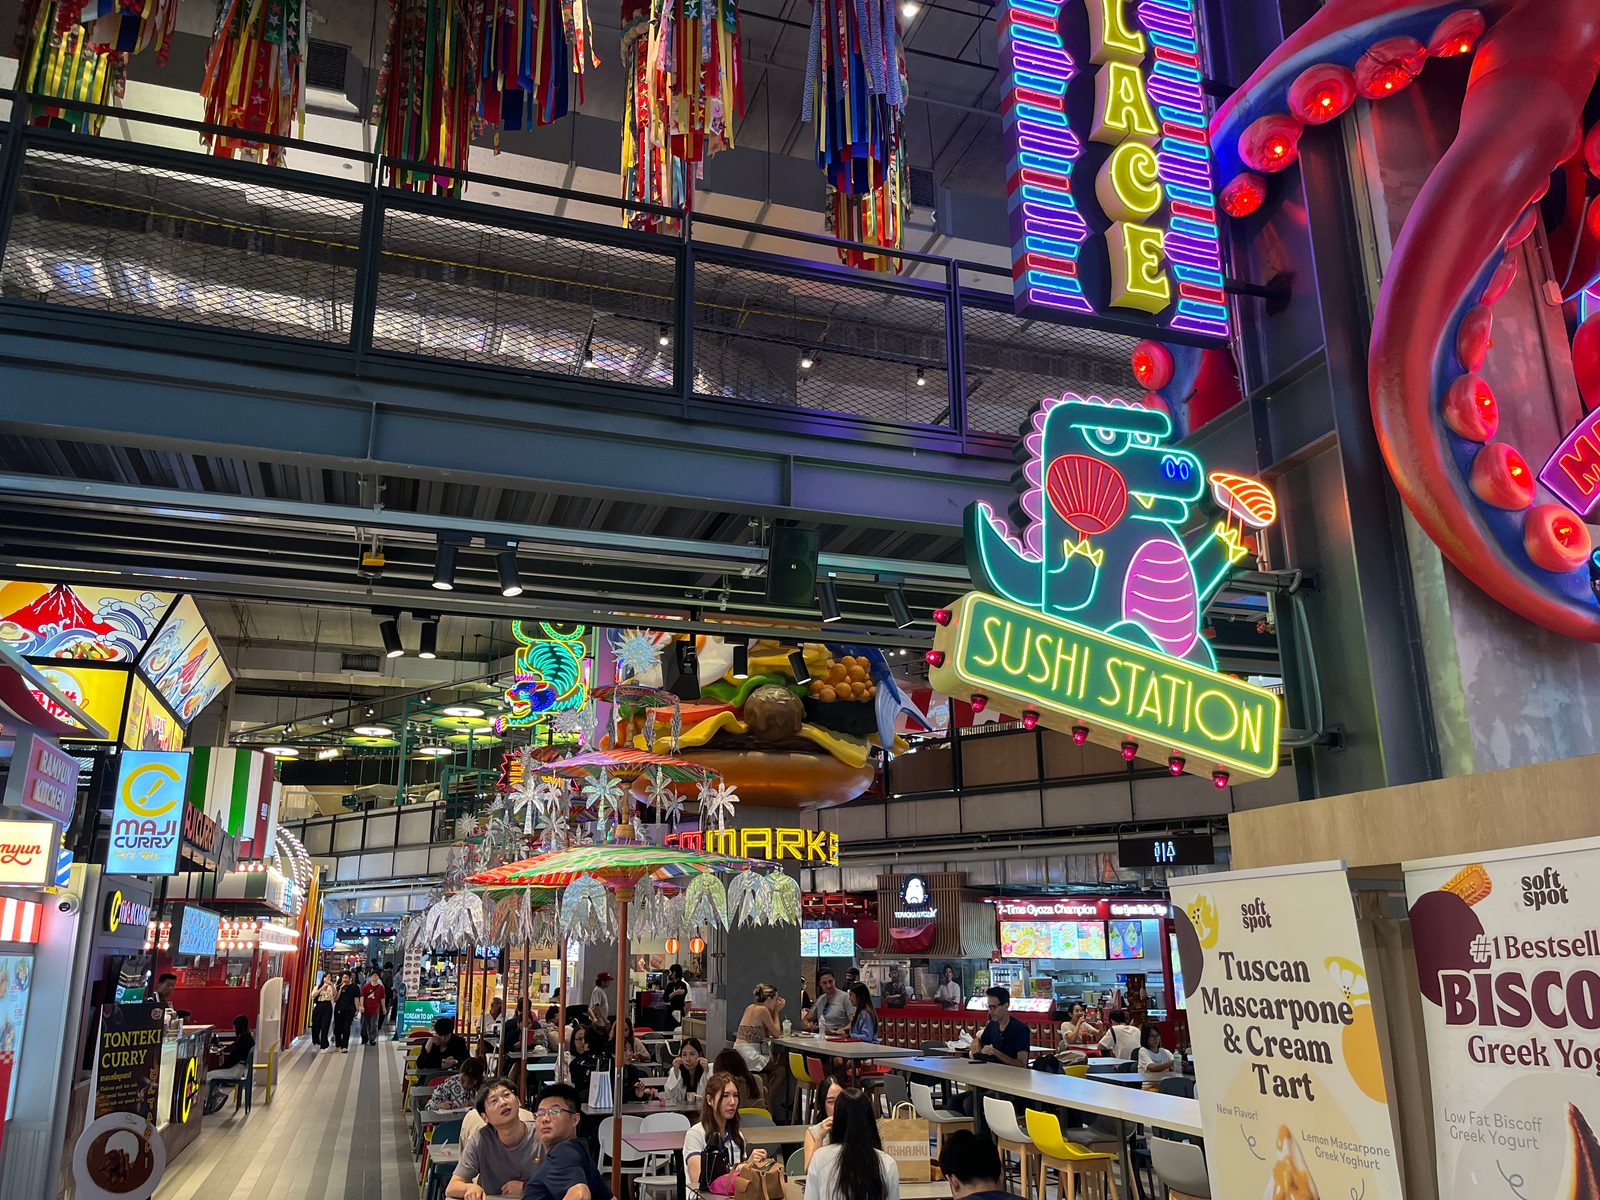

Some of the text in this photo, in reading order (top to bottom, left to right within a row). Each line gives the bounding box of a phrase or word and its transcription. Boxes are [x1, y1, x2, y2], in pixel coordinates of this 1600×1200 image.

[973, 617, 1263, 753] SUSHI STATION
[39, 750, 72, 785] RAMYUN
[33, 779, 66, 812] KITCHEN
[115, 819, 177, 836] MAJI
[114, 837, 174, 849] CURRY
[1521, 867, 1561, 892] soft
[1027, 904, 1054, 916] Gyoza
[1054, 904, 1097, 916] Champion
[1241, 898, 1266, 917] soft
[1523, 885, 1569, 911] spot
[1243, 913, 1272, 932] spot
[1472, 936, 1502, 962] #1
[1219, 952, 1310, 983] Tuscan
[1201, 987, 1354, 1030] Mascarpone
[1441, 969, 1600, 1030] BISCO
[103, 1029, 162, 1049] TONTEKI
[1223, 1024, 1333, 1064] & Cream
[1468, 1034, 1550, 1067] Greek
[101, 1049, 148, 1068] CURRY
[1252, 1063, 1315, 1101] Tart
[1216, 1103, 1258, 1121] New Flavor!
[1444, 1108, 1542, 1133] Low Fat Biscoff
[1301, 1130, 1391, 1158] Lemon Mascarpone
[1450, 1125, 1540, 1152] Greek Yogurt
[1315, 1146, 1381, 1171] Greek Yoghurt
